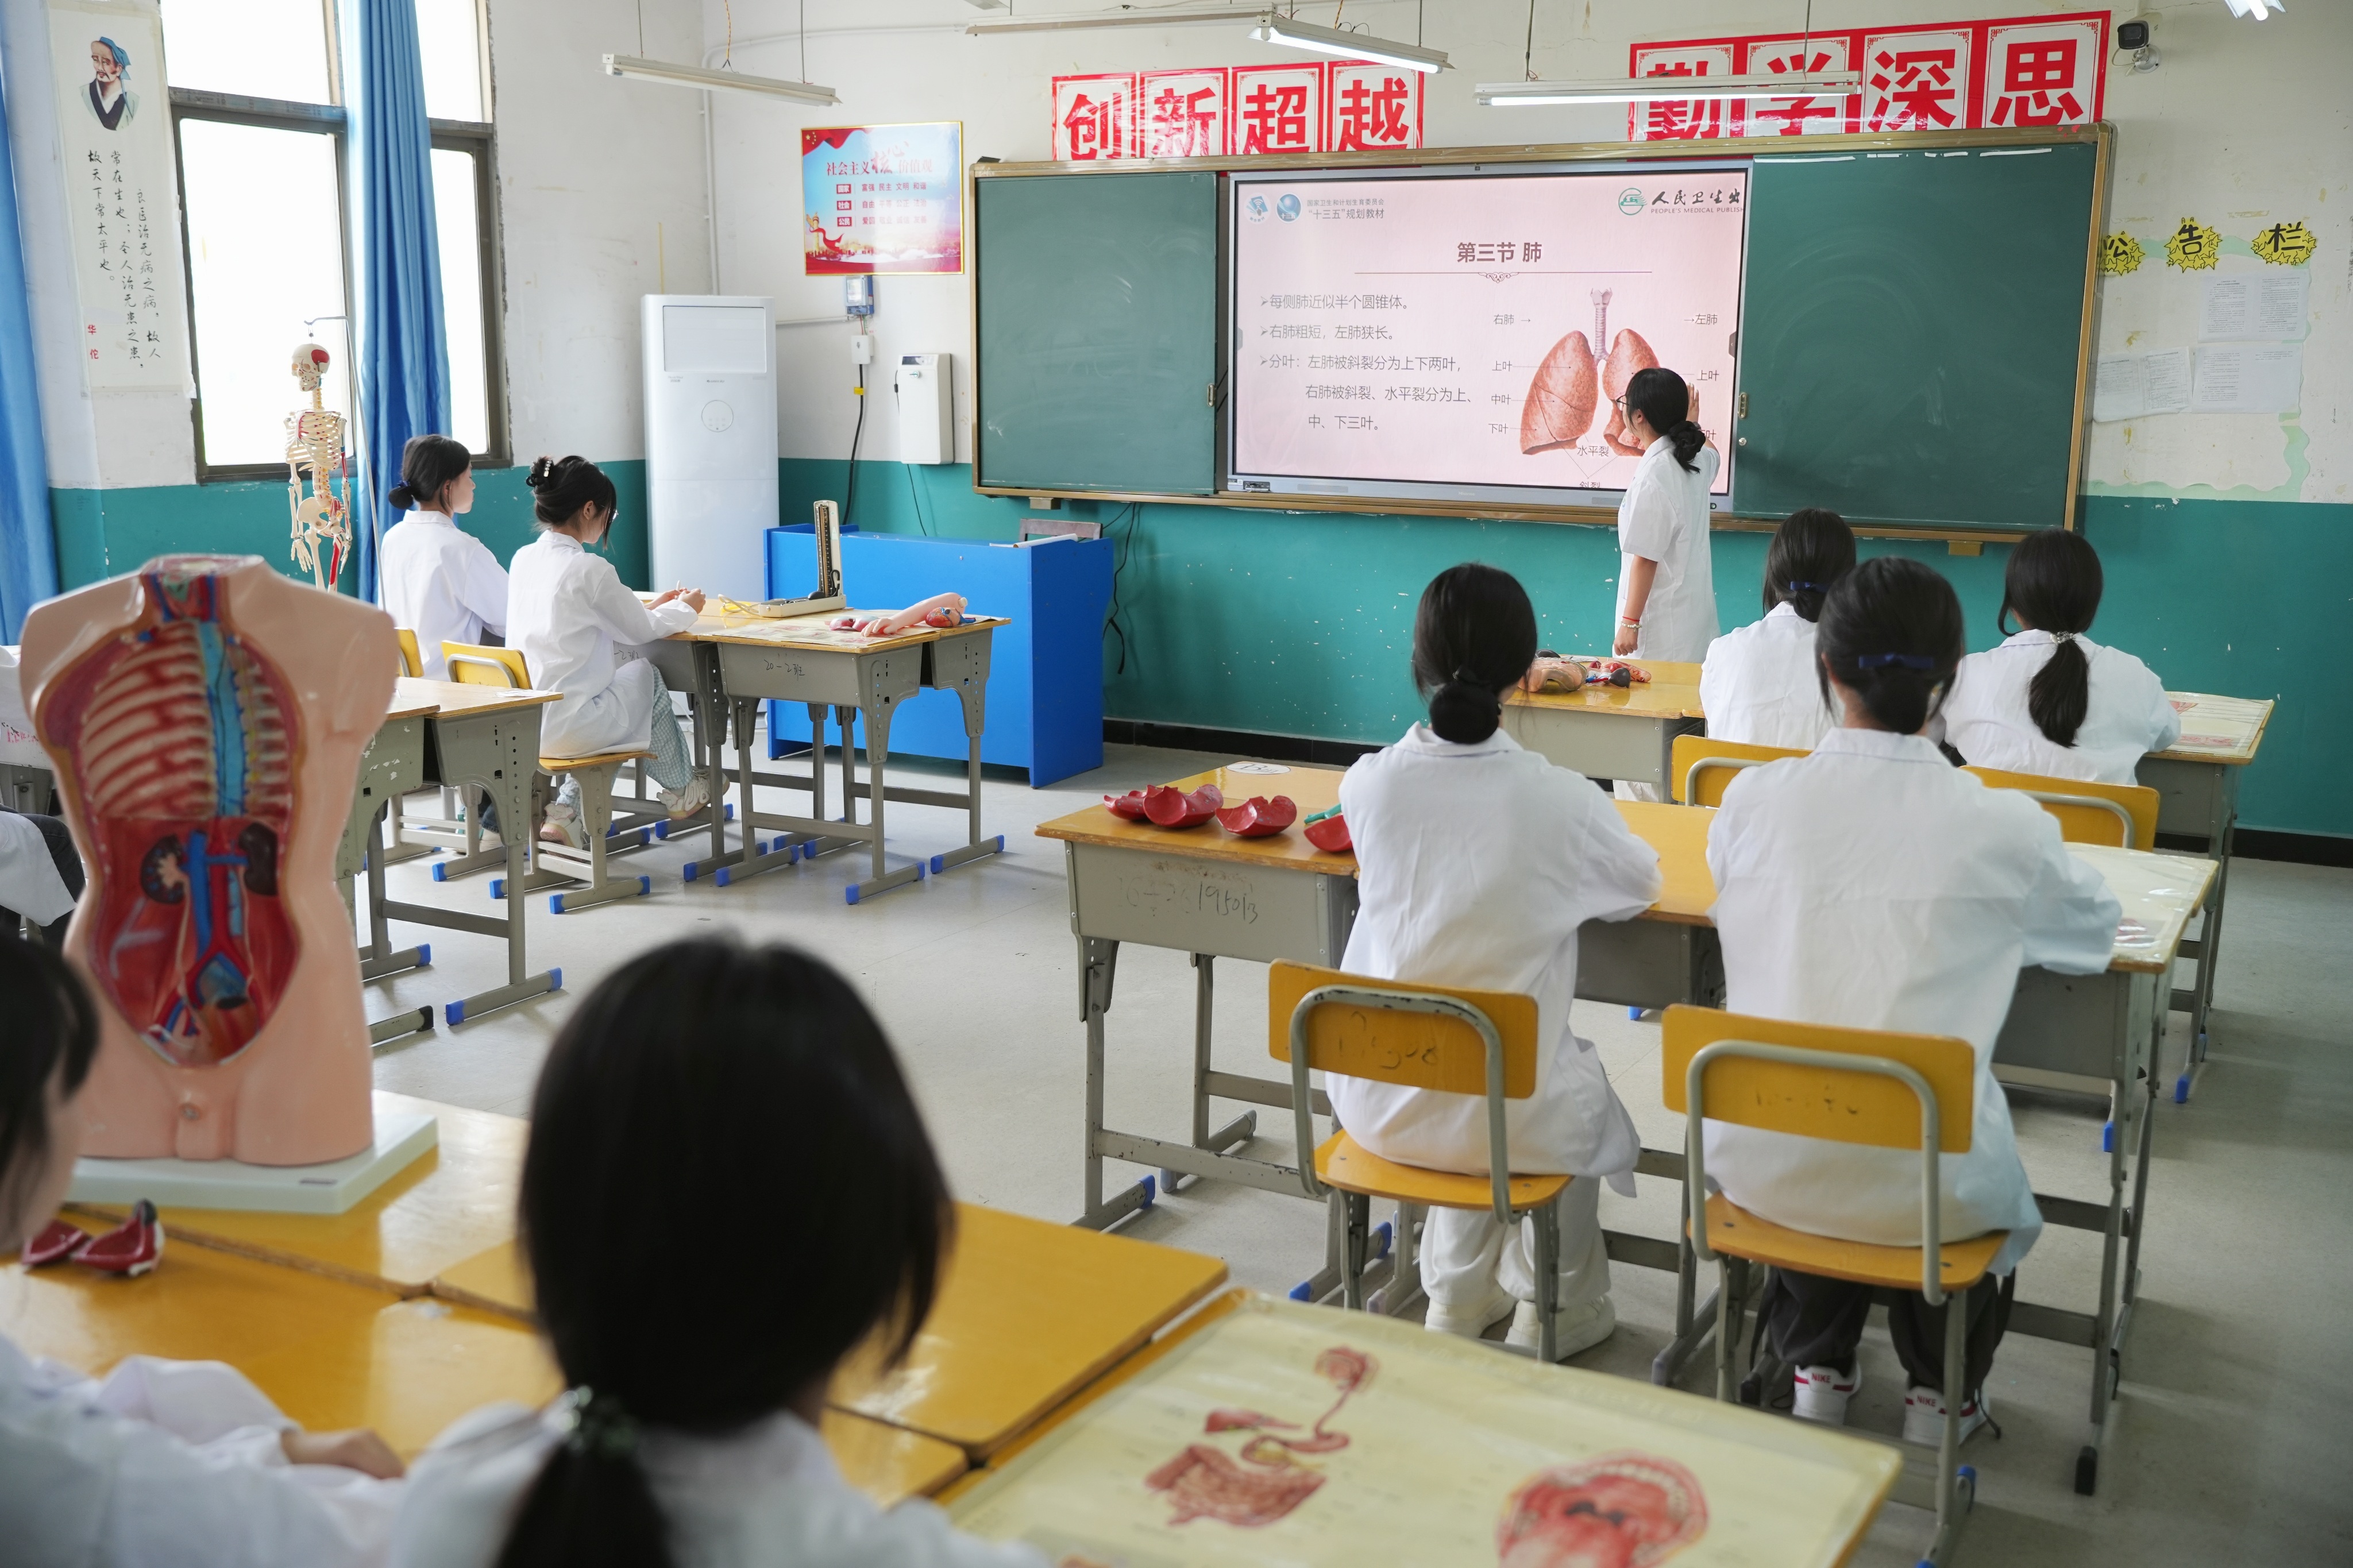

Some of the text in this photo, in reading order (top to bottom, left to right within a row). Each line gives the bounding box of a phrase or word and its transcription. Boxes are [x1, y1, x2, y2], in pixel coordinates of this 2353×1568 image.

[1062, 77, 1409, 161] 创新超越
[827, 141, 933, 176] 社会主义核心价值观
[862, 183, 875, 192] 富强
[879, 183, 892, 191] 民主
[896, 182, 909, 191] 文明
[913, 181, 927, 190] 和谐
[1307, 198, 1384, 207] 国家卫生和计划生育委员会
[1651, 188, 1741, 206] 人民卫生出
[862, 200, 875, 208] 自由
[862, 217, 875, 225] 爱国
[2108, 221, 2306, 258] 公告栏
[1457, 242, 1542, 263] 第三节 肺
[1270, 295, 1408, 310] 每侧肺近似半个圆锥体。
[1494, 314, 1515, 325] 右肺
[1695, 314, 1718, 325] 左肺
[87, 324, 99, 360] 华佗
[1492, 361, 1513, 372] 上叶
[1696, 370, 1719, 381] 上叶
[1491, 393, 1511, 405] 中叶
[1308, 414, 1379, 431] 中、下三叶。
[1488, 423, 1509, 434] 下叶
[1577, 445, 1609, 457] 水平裂
[1811, 1372, 1831, 1384] NIKE
[1916, 1395, 1937, 1408] NIKE
